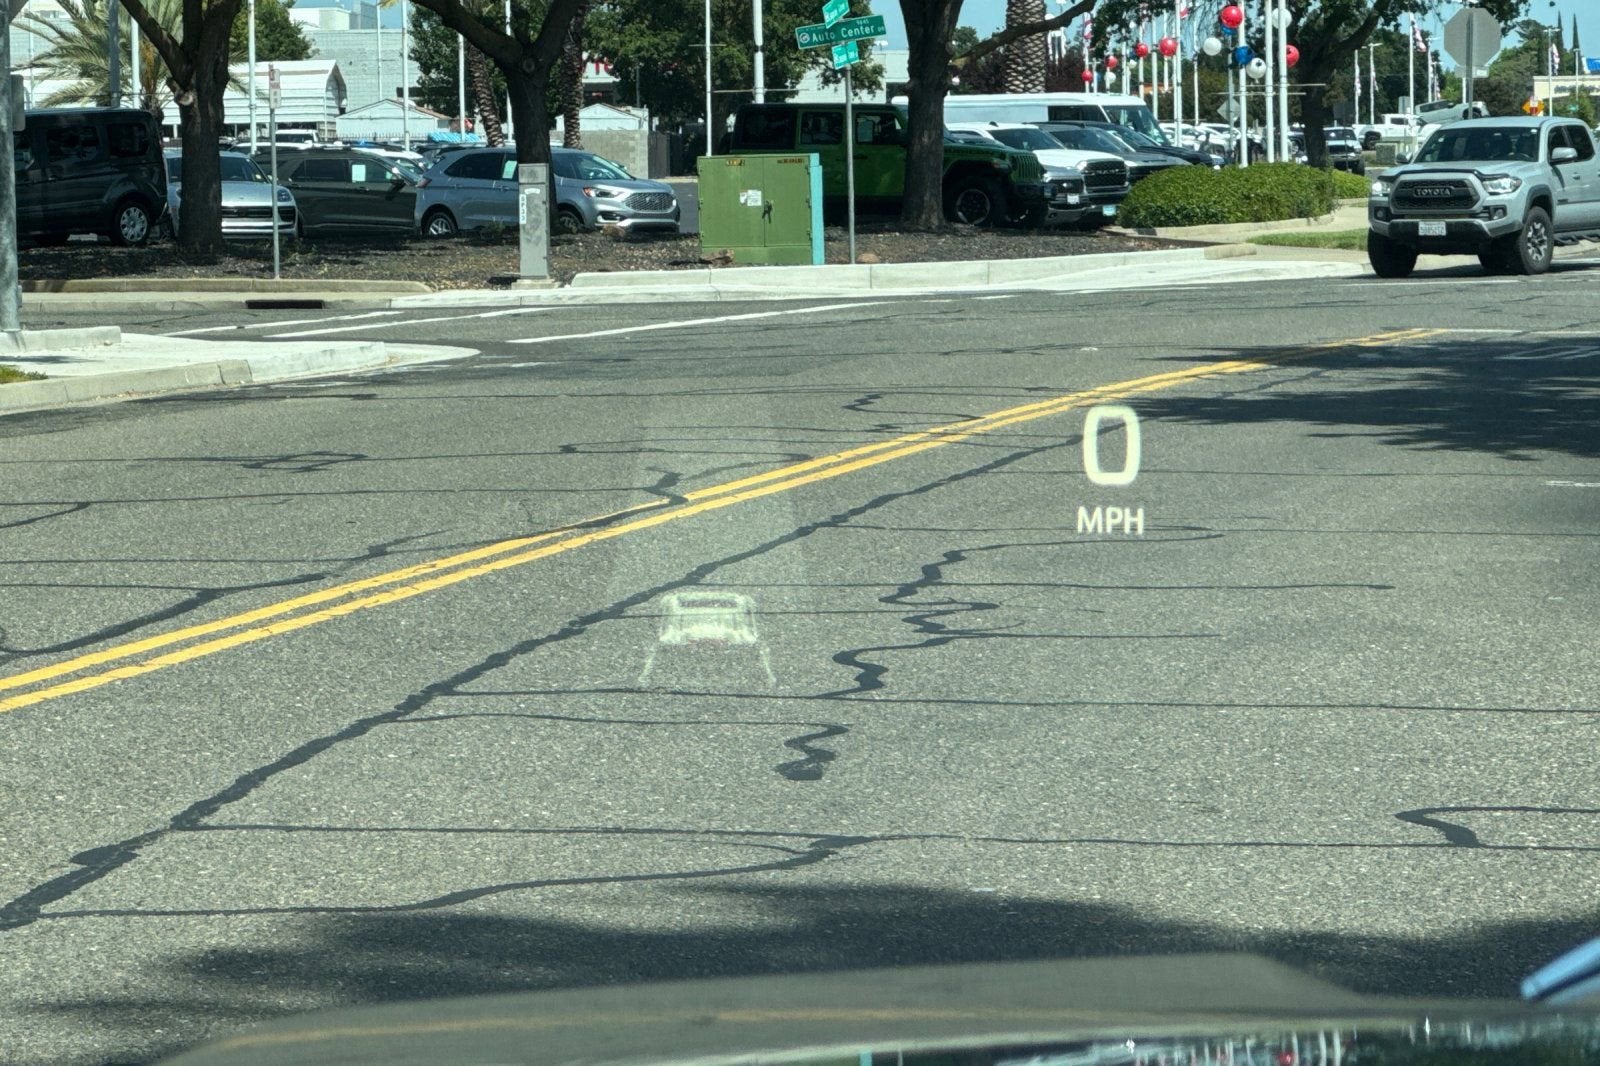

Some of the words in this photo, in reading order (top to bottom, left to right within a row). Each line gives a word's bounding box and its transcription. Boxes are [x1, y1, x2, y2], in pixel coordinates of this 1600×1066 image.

[812, 32, 835, 43] Auto
[841, 25, 875, 38] Center
[1417, 188, 1450, 196] TOYOTA
[1077, 506, 1145, 535] MPH
